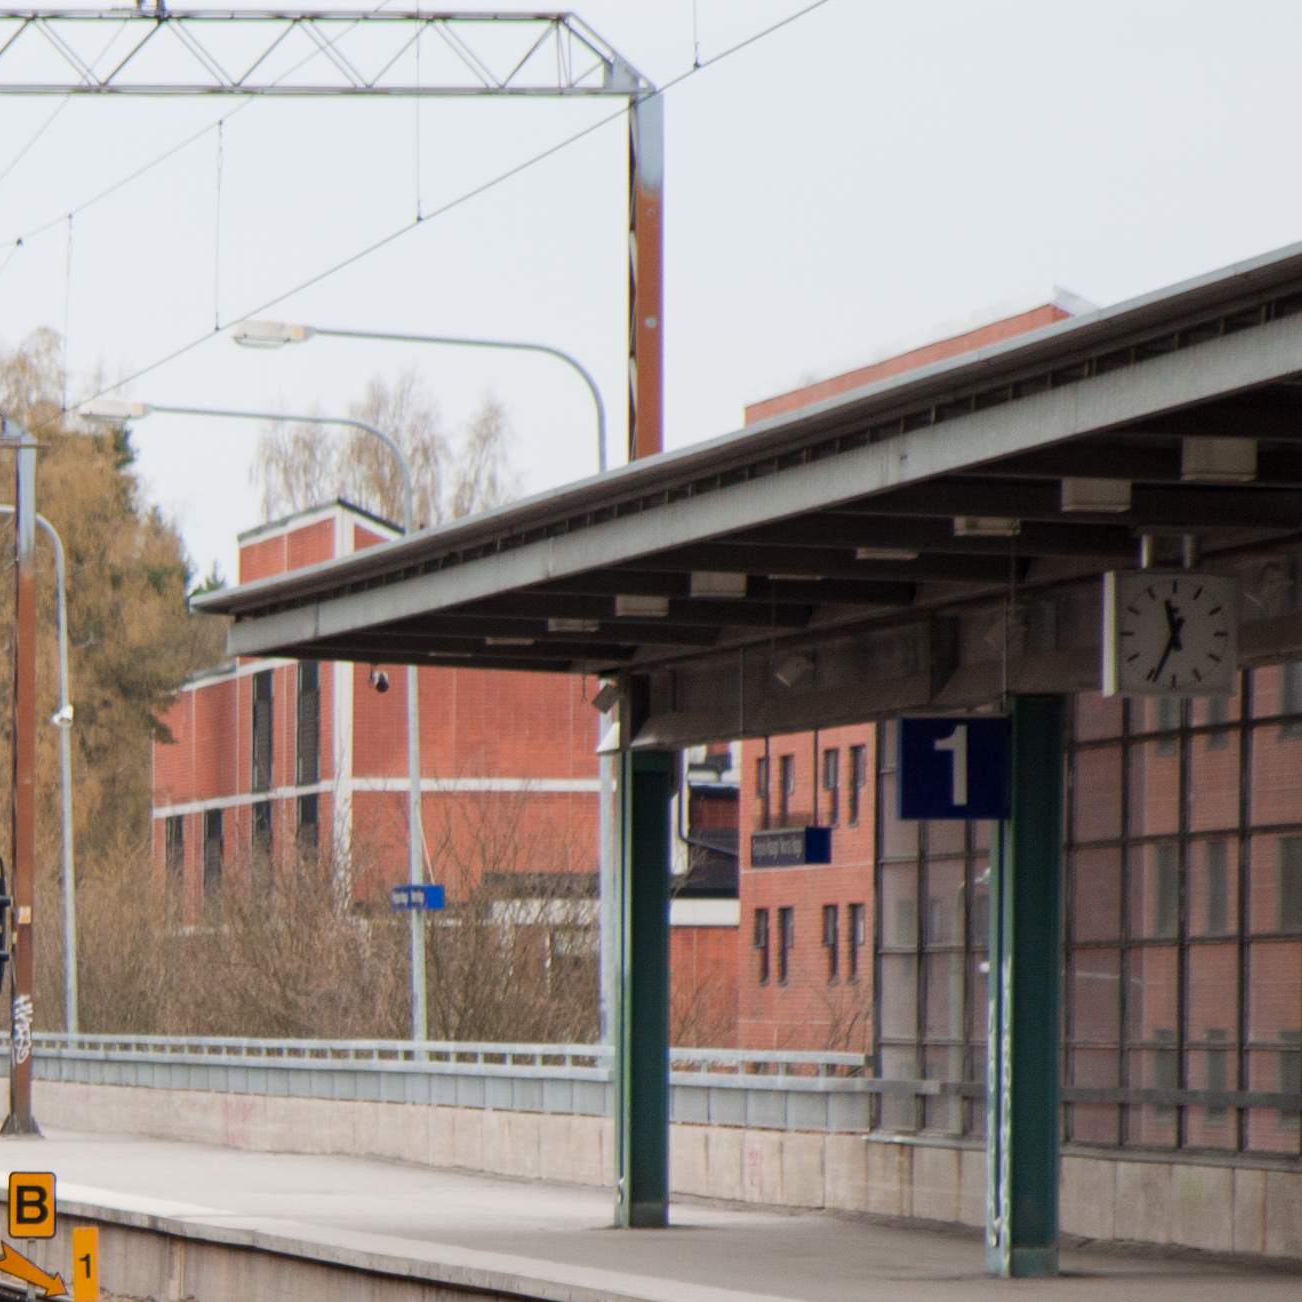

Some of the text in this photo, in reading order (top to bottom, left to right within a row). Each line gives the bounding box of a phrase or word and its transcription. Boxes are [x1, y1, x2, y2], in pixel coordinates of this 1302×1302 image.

[933, 723, 969, 807] 1
[16, 1185, 49, 1225] B
[79, 1253, 92, 1278] 1
